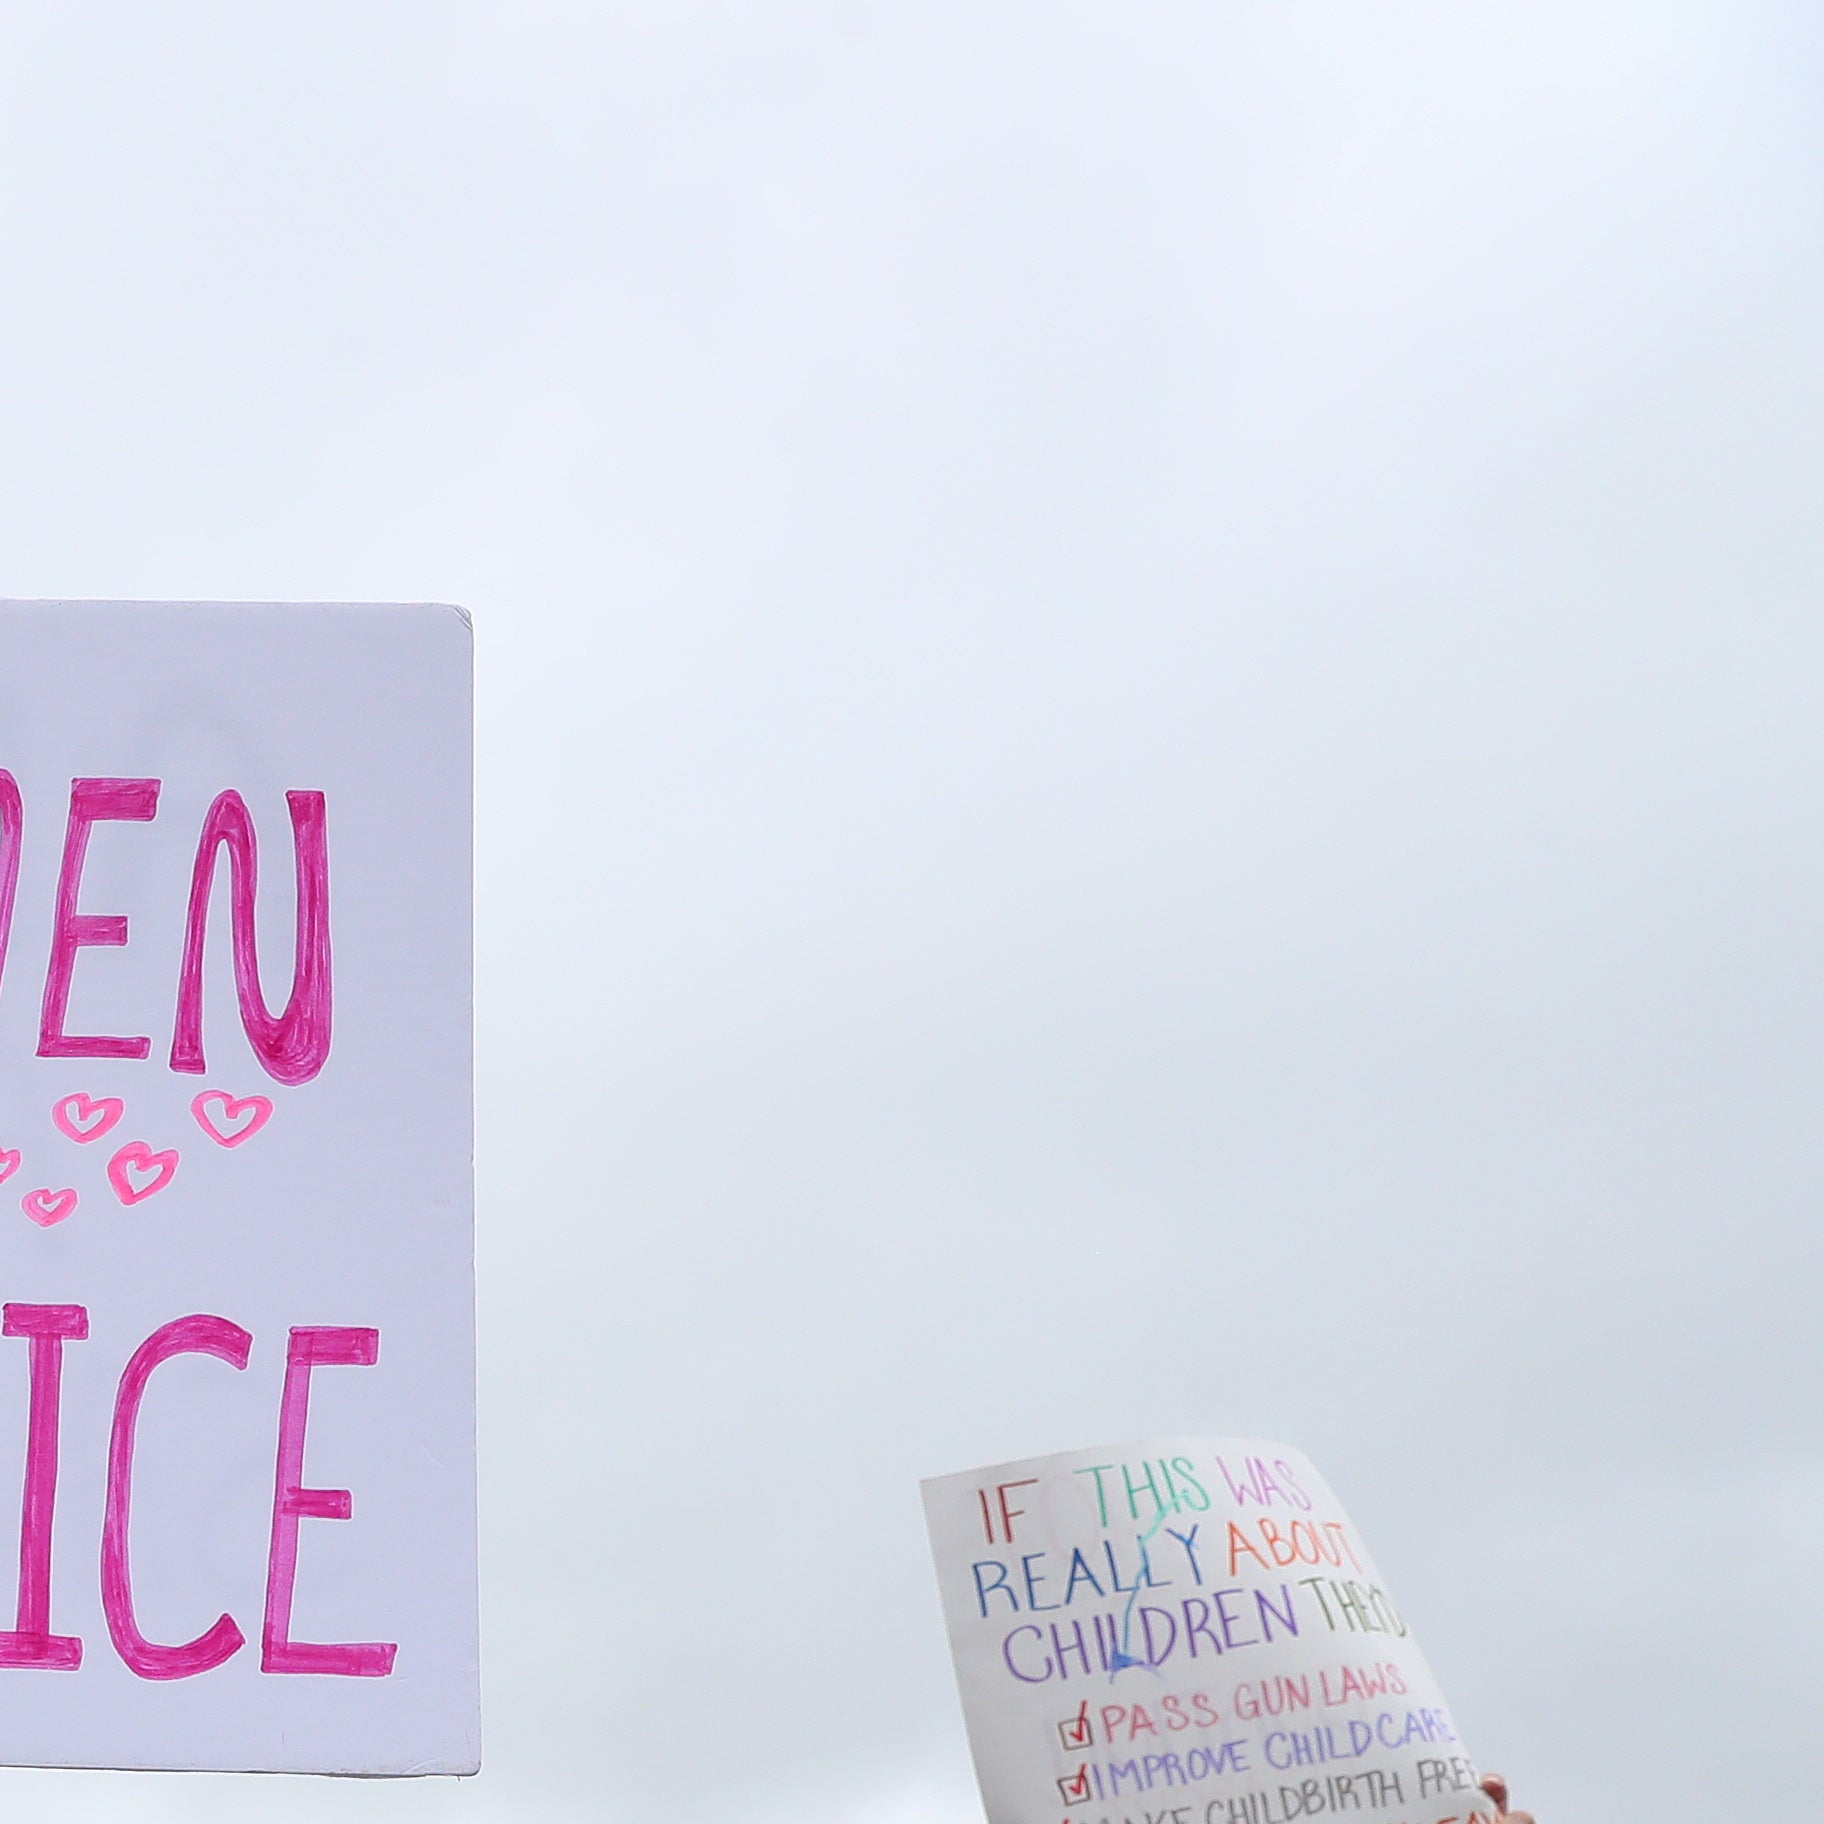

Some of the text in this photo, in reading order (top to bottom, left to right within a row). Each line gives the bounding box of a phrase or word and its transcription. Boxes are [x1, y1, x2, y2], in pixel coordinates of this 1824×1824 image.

[978, 1454, 1313, 1545] IF THIS WAS
[970, 1516, 1363, 1618] REALLY ABOUT
[1002, 1583, 1300, 1684] CHILDREN
[1099, 1661, 1409, 1746] PASS GUN LAWS
[1091, 1737, 1252, 1801] IMPROVE
